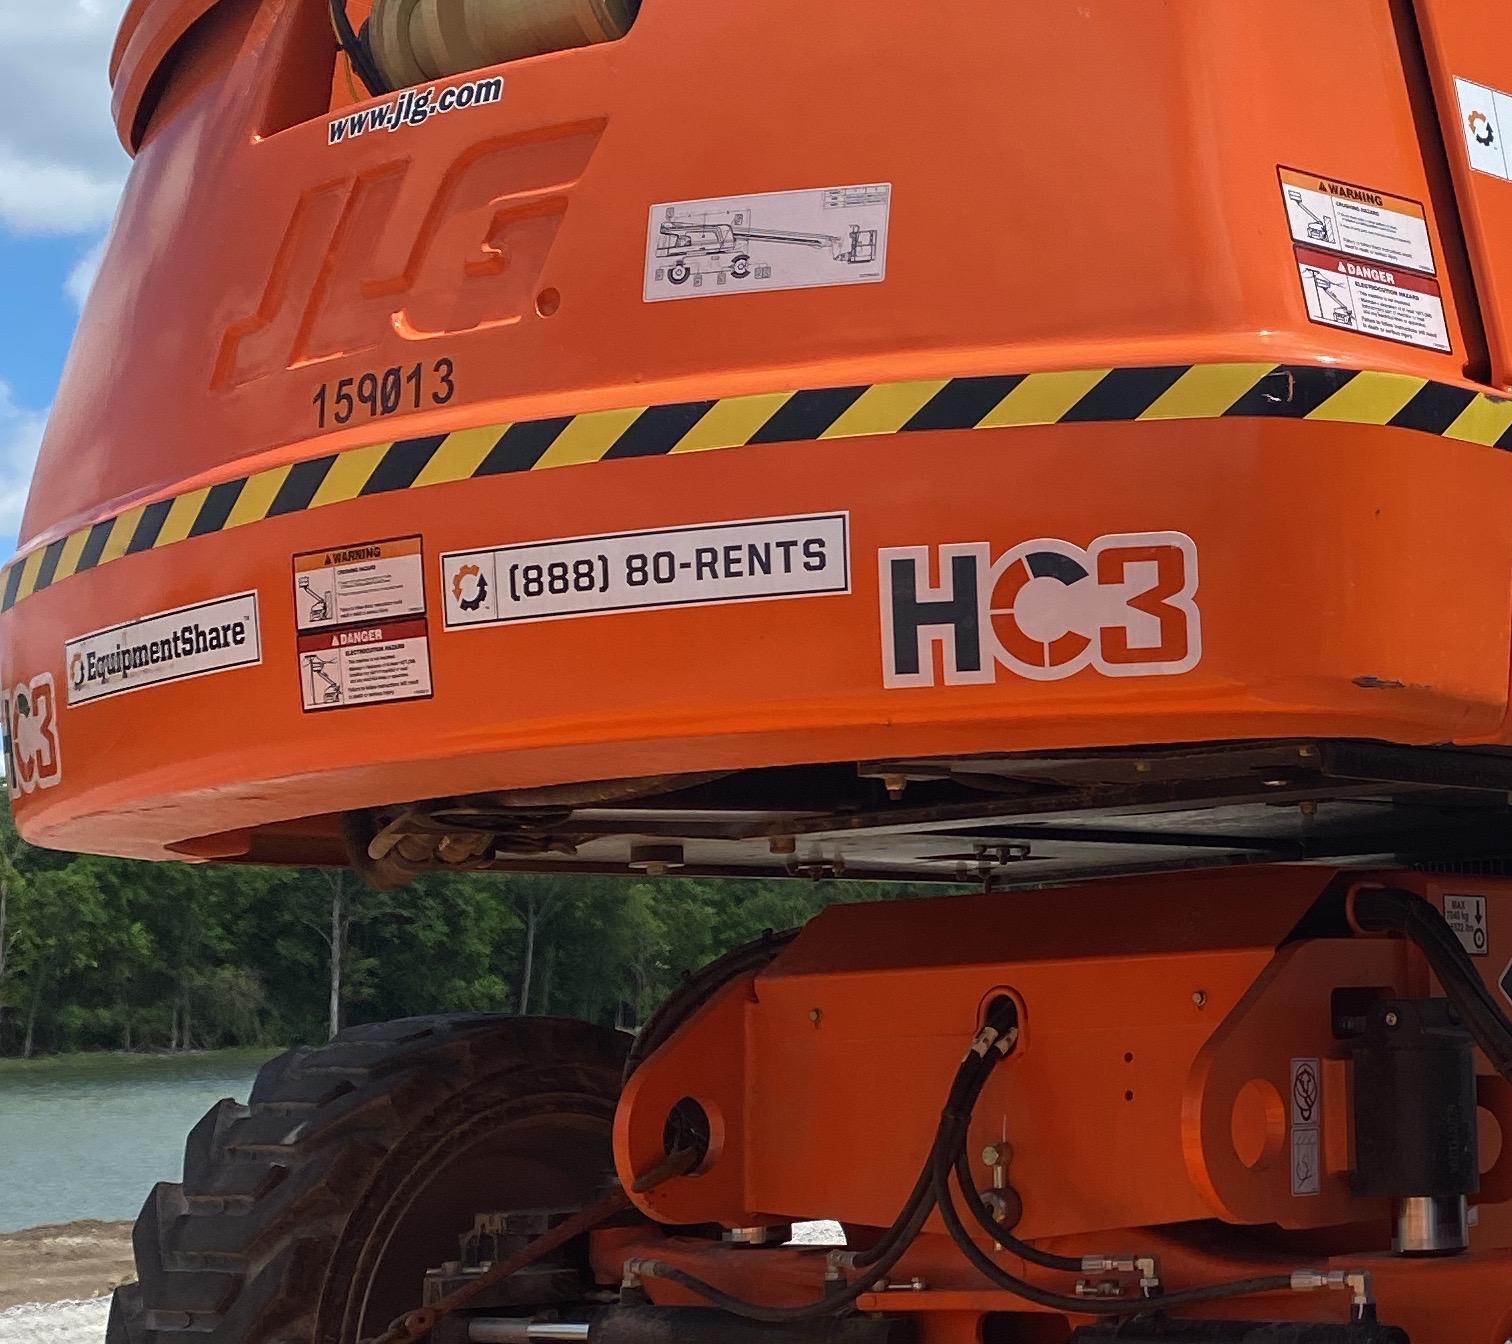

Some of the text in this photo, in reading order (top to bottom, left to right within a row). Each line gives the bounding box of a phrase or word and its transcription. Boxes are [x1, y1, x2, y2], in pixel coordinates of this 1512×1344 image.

[328, 77, 502, 143] www.jlg.com
[1328, 183, 1383, 206] WARNING
[208, 115, 610, 392] JLG
[1347, 262, 1395, 285] DANGER
[333, 546, 381, 566] WARNING
[508, 537, 828, 602] (888) 80-RENTS
[340, 628, 383, 646] DANGER
[886, 540, 1194, 680] HC3
[86, 619, 247, 685] EquipmentShare
